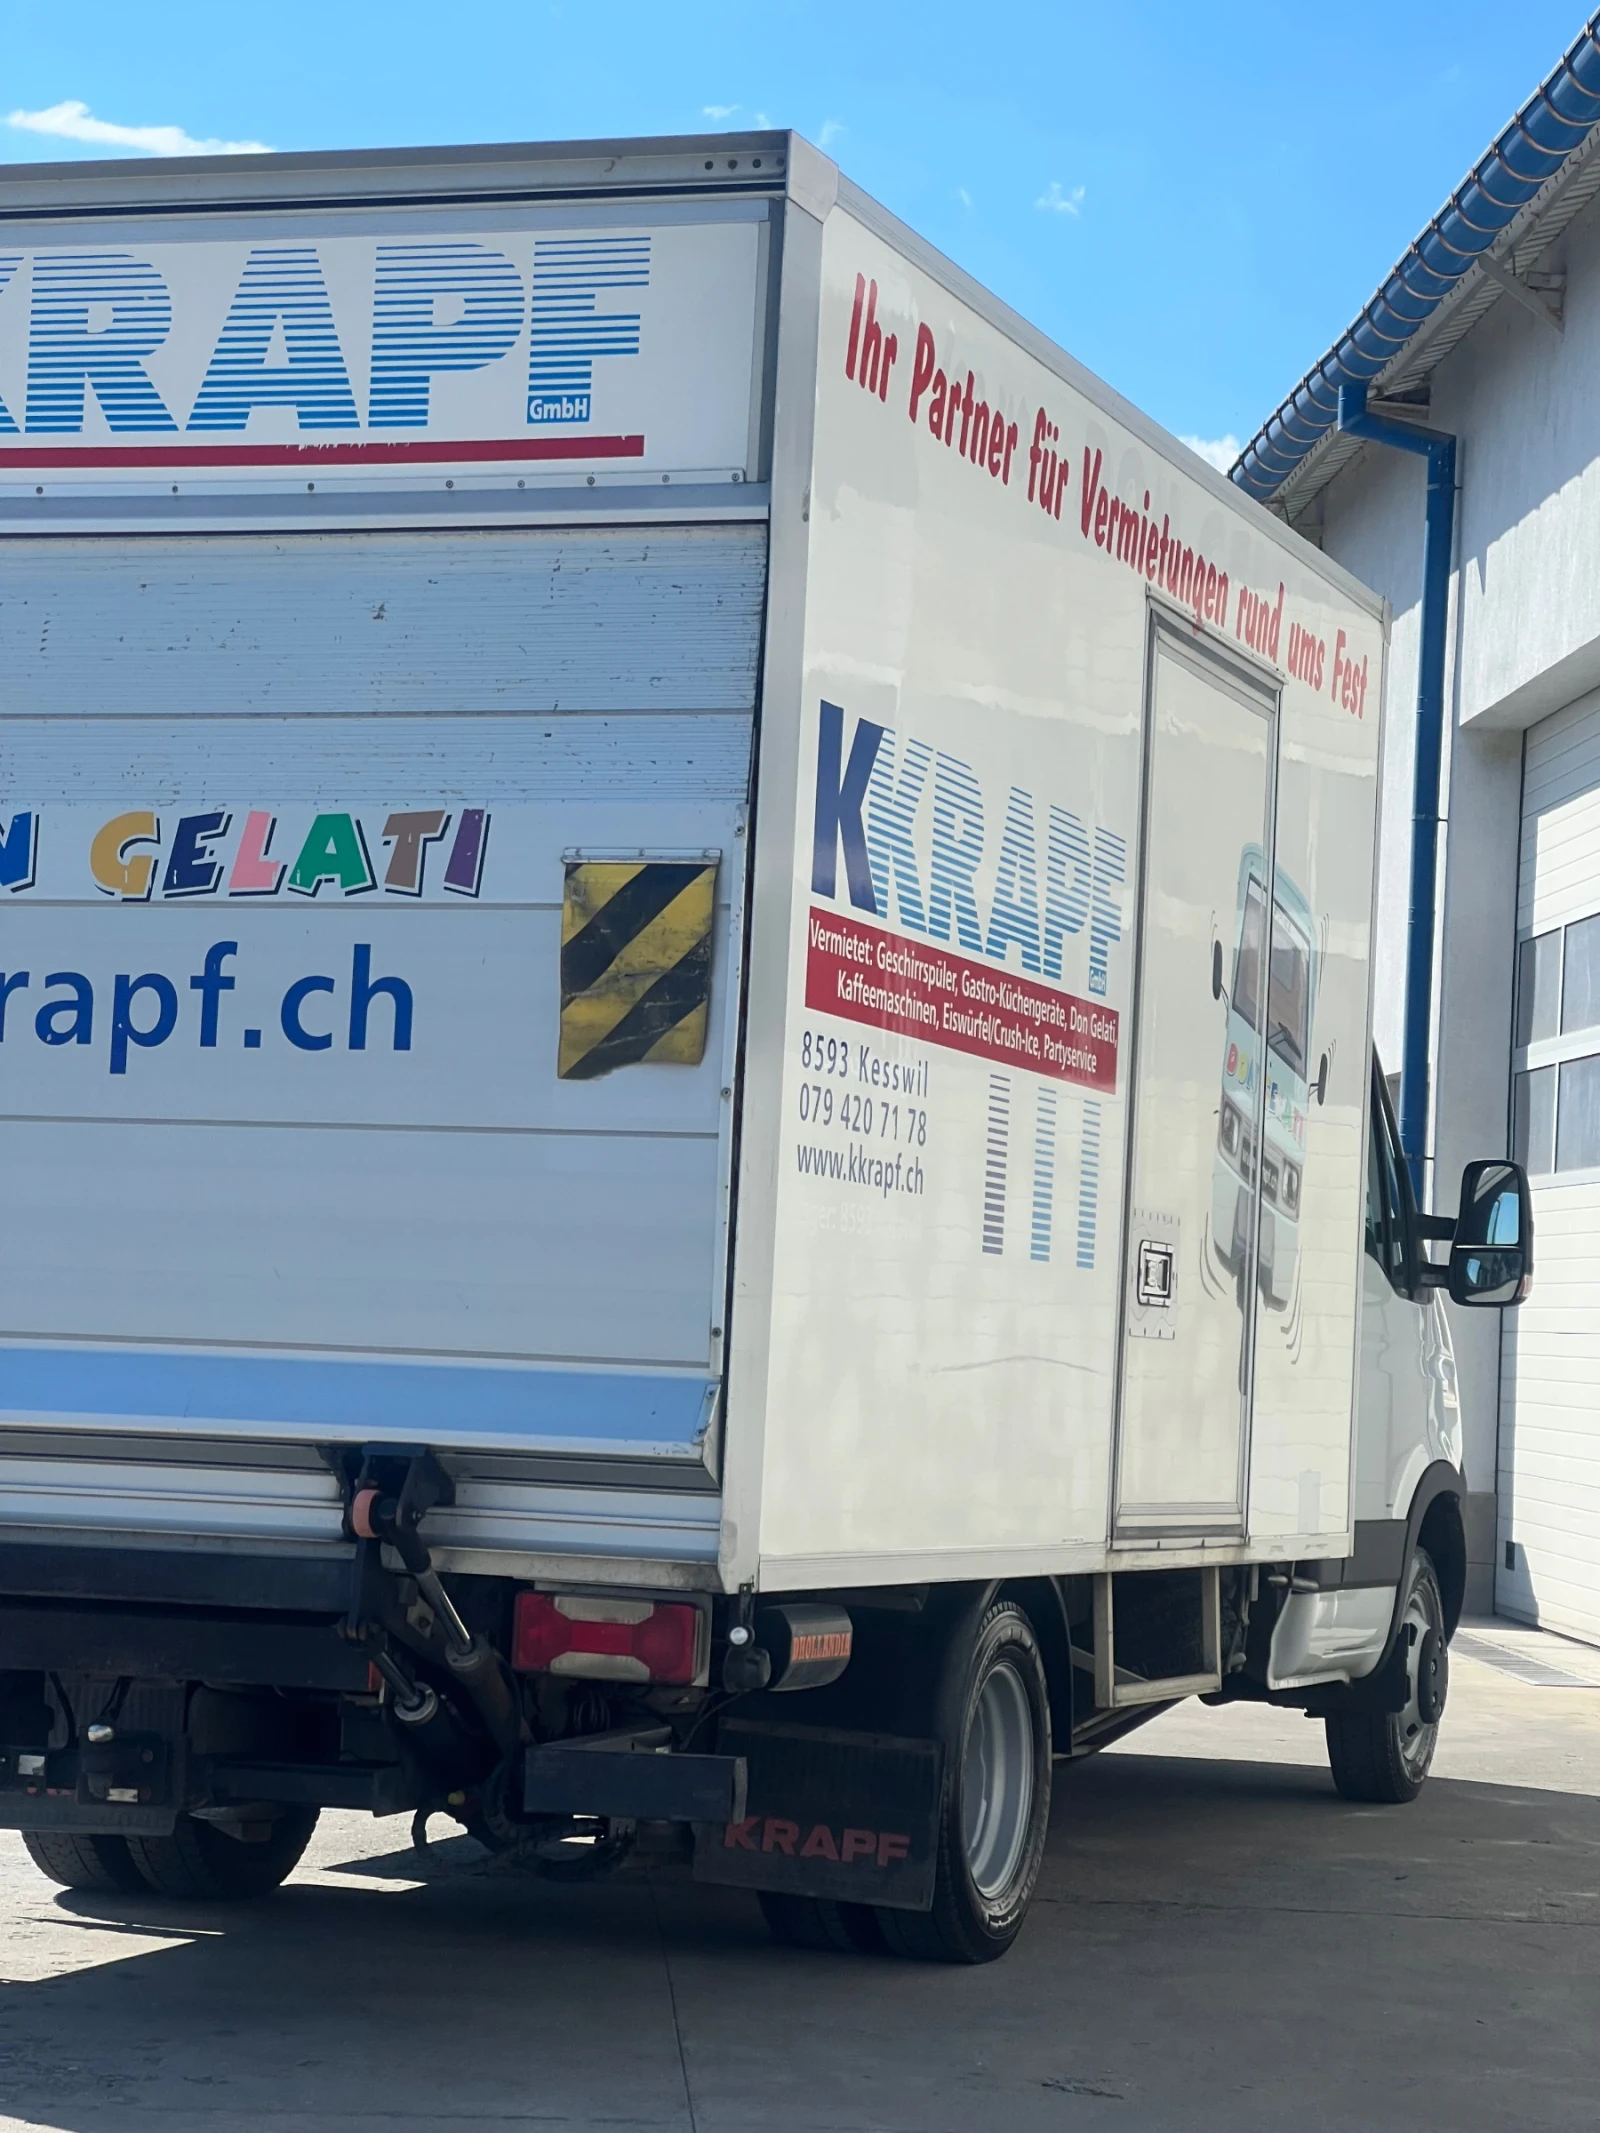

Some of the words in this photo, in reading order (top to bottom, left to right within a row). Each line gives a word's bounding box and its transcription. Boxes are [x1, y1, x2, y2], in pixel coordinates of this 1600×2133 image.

[0, 237, 651, 433] RAPF
[530, 402, 588, 421] GmbH
[845, 272, 898, 402] Ihr
[909, 321, 1018, 486] Partner
[1027, 406, 1069, 521] für
[1080, 446, 1229, 637] Vermietungen
[1236, 581, 1285, 664] rund
[1287, 614, 1325, 691] ums
[1330, 628, 1368, 720] Fest
[89, 809, 492, 902] GELATI
[810, 918, 873, 966] Vermietet:
[876, 941, 958, 996] Geschirrspüler,
[961, 969, 1067, 1031] Gastro-Küchengeräte,
[1070, 1005, 1089, 1035] Don
[1090, 1013, 1118, 1048] Gelati,
[837, 969, 939, 1030] Kaffeemaschinen,
[942, 1002, 1041, 1060] Eiswürfel/Crush-Ice,
[1043, 1033, 1097, 1073] Partyservice
[801, 1030, 848, 1078] 8593
[858, 1045, 928, 1098] Kesswil
[799, 1082, 833, 1126] 079
[840, 1093, 873, 1135] 420
[881, 1101, 899, 1140] 71
[908, 1108, 927, 1147] 78
[797, 1142, 924, 1199] www.kkrapf.ch
[792, 1632, 851, 1662] DHOLLANDIA
[724, 1815, 911, 1867] KRAPF
